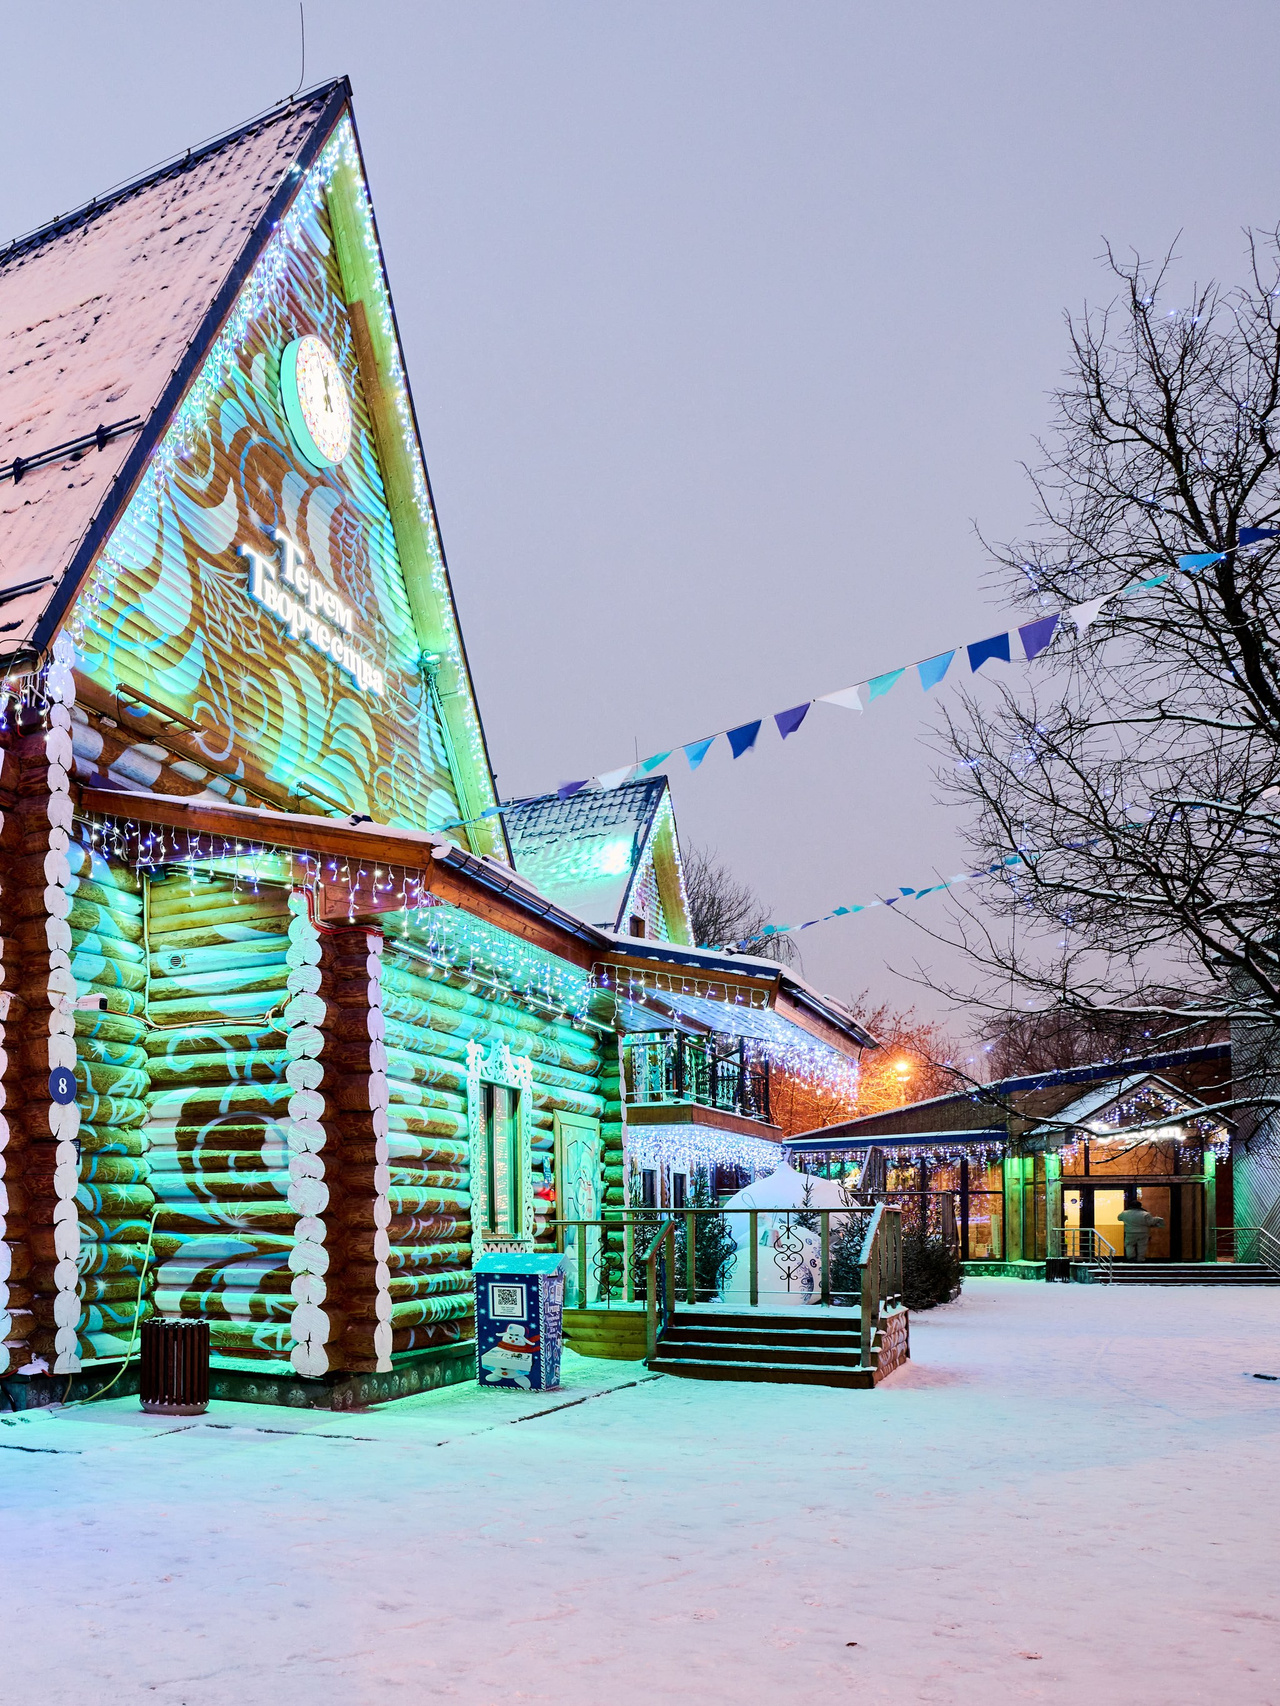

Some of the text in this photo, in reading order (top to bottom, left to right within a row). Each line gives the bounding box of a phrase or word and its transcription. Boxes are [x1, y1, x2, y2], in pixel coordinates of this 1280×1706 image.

[241, 543, 385, 697] Творчества
[274, 527, 353, 635] Терем
[58, 1077, 67, 1094] 8
